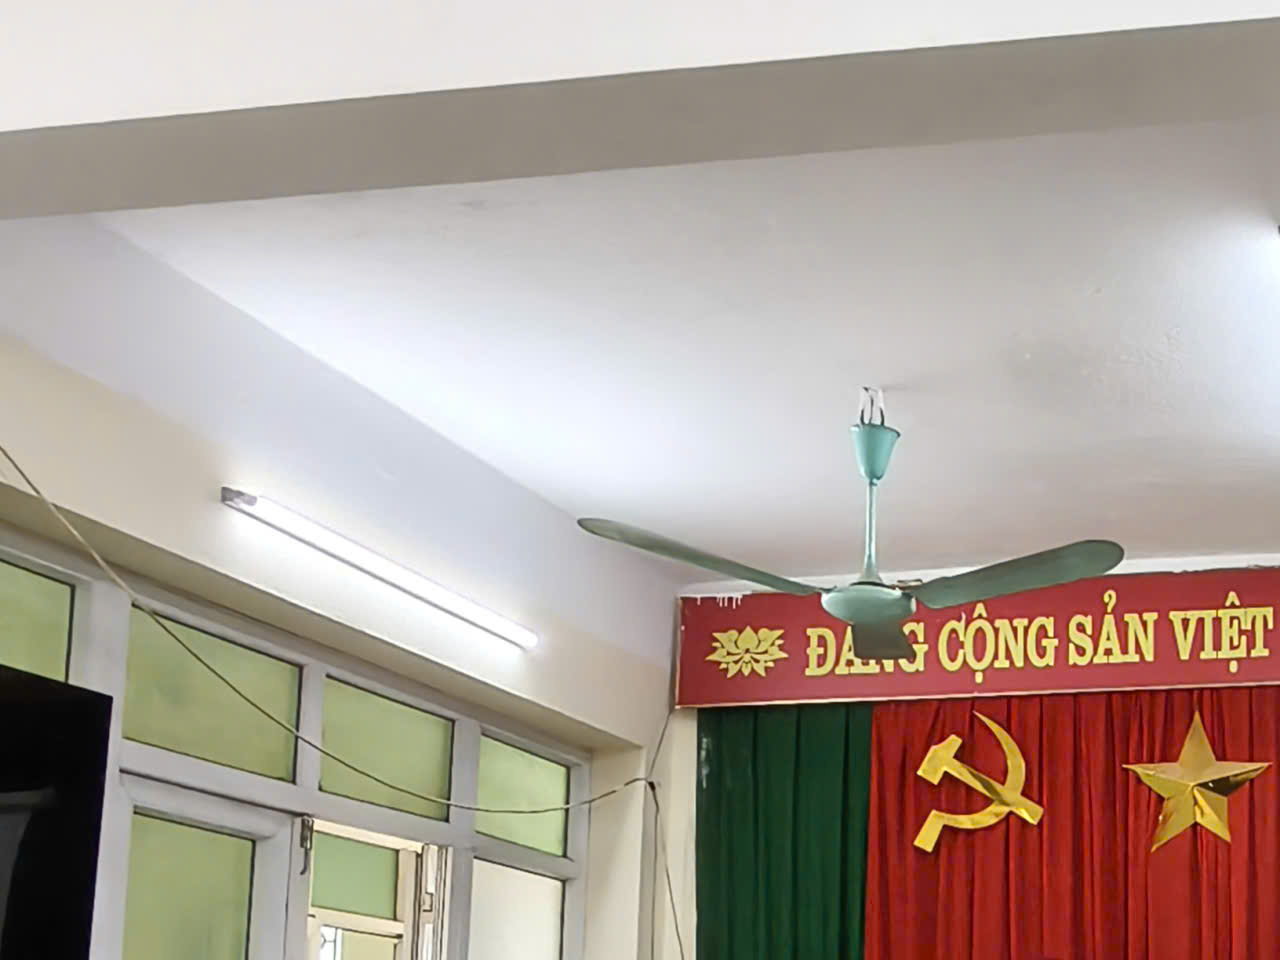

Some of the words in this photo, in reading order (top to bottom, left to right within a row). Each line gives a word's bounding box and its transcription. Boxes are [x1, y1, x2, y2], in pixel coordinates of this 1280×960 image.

[939, 603, 1059, 683] CỘNG
[1068, 591, 1157, 666] SẢN
[1169, 591, 1274, 673] VIỆT
